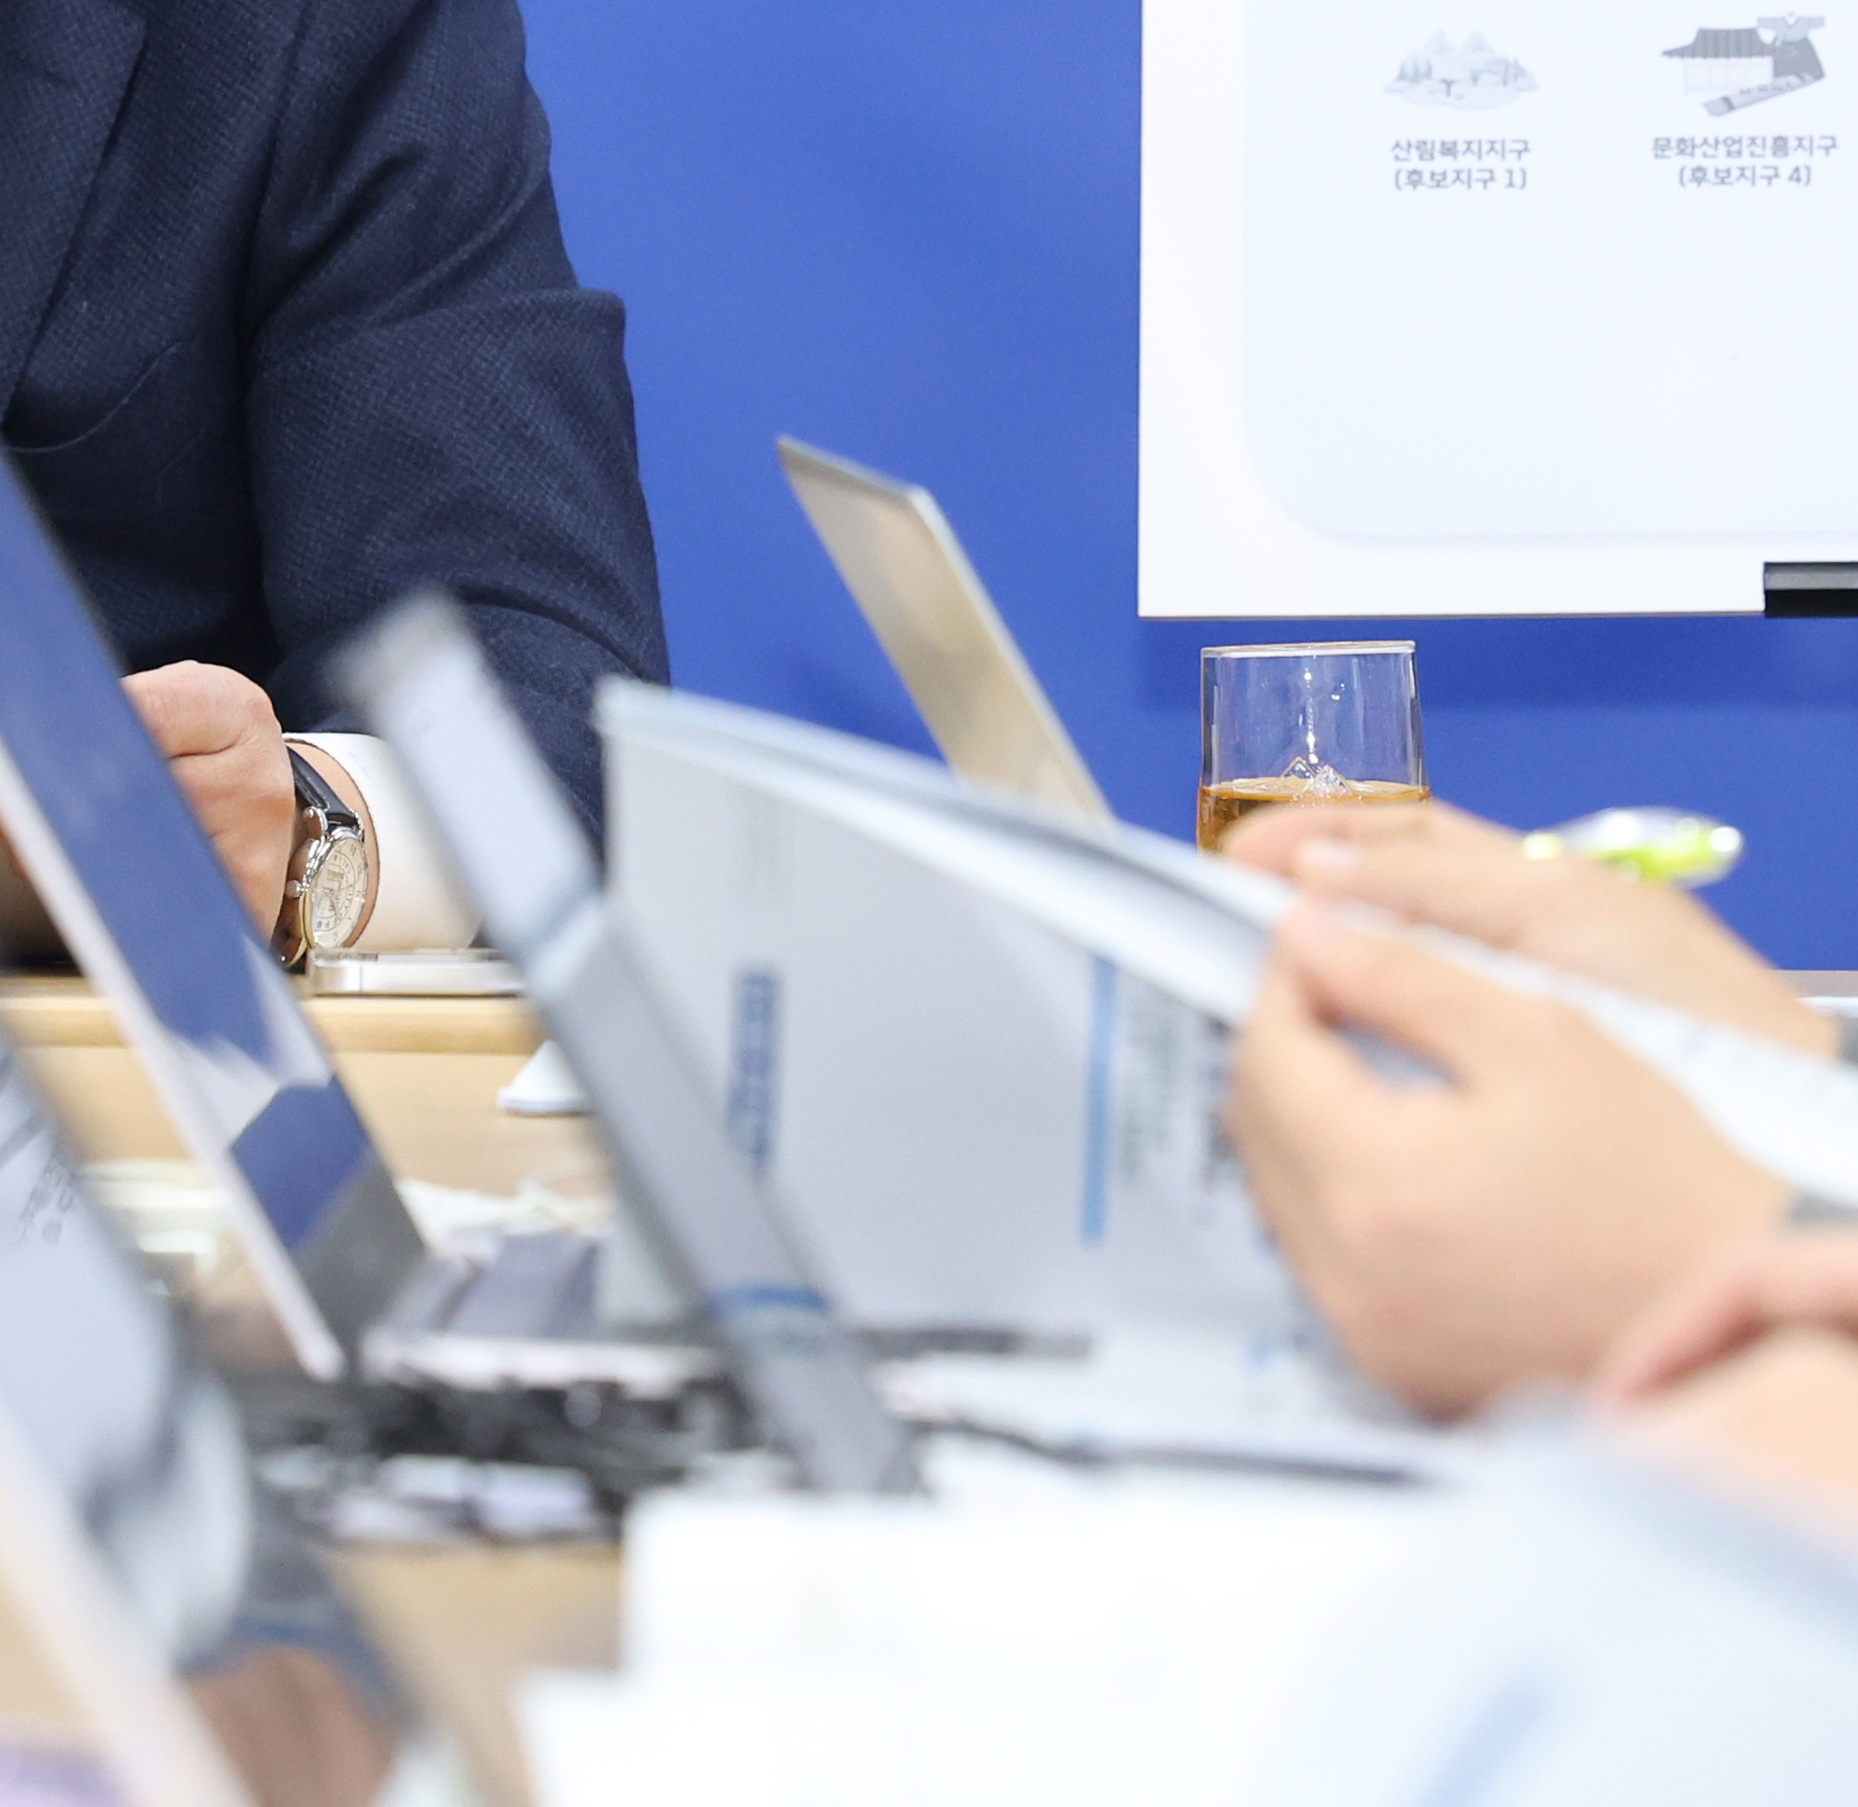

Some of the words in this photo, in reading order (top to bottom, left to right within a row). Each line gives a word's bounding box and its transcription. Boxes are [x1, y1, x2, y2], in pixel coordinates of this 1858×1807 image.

[1390, 138, 1532, 162] 산림복지지구
[1651, 134, 1840, 160] 문화산업진흥지구
[1394, 167, 1497, 191] (후보지구
[1504, 167, 1528, 191] 1)
[1678, 164, 1782, 188] (후보지구
[1787, 164, 1813, 187] 4)
